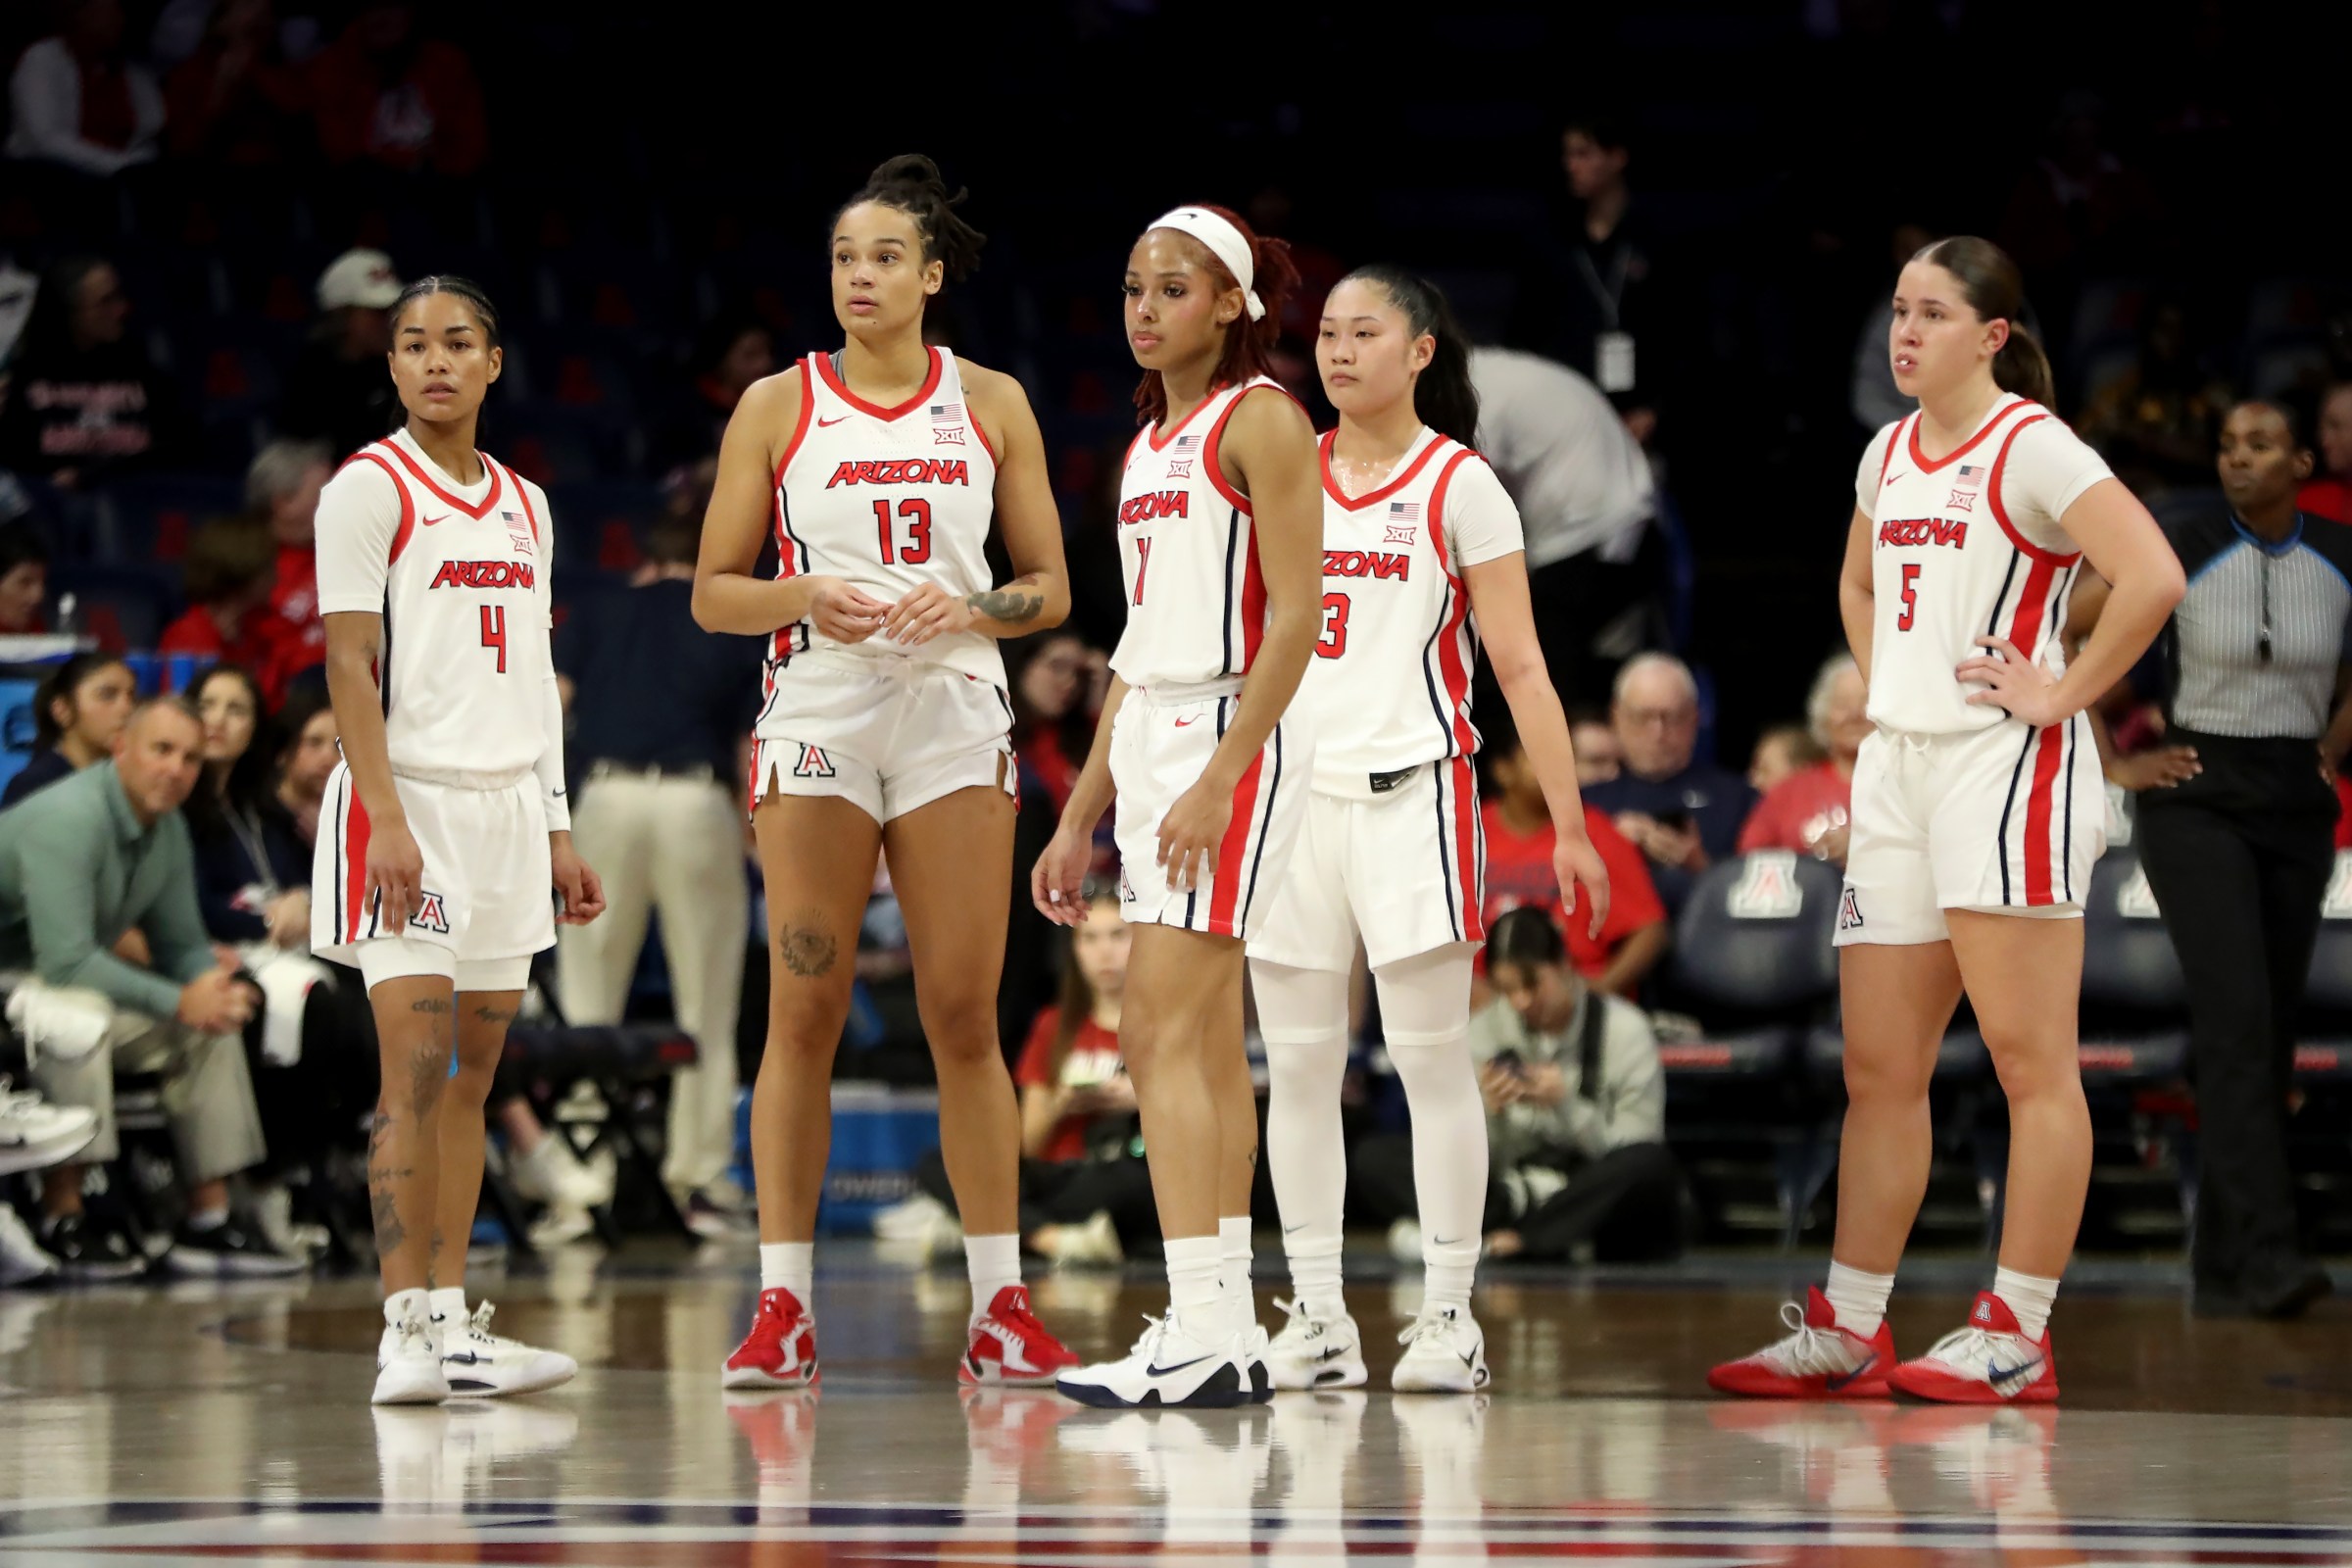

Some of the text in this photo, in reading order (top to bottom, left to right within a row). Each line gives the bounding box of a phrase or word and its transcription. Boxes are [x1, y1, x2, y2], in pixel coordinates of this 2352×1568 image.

[932, 426, 966, 446] XII
[825, 458, 969, 490] ARIZONA
[1118, 490, 1190, 530] RIZONA
[872, 498, 931, 564] 13
[1383, 524, 1417, 546] XII
[1876, 517, 1968, 551] ARIZONA
[1323, 550, 1410, 582] ZONA
[1897, 564, 1921, 632] 5
[479, 605, 506, 674] 4
[793, 742, 836, 778] A
[409, 890, 450, 935] A
